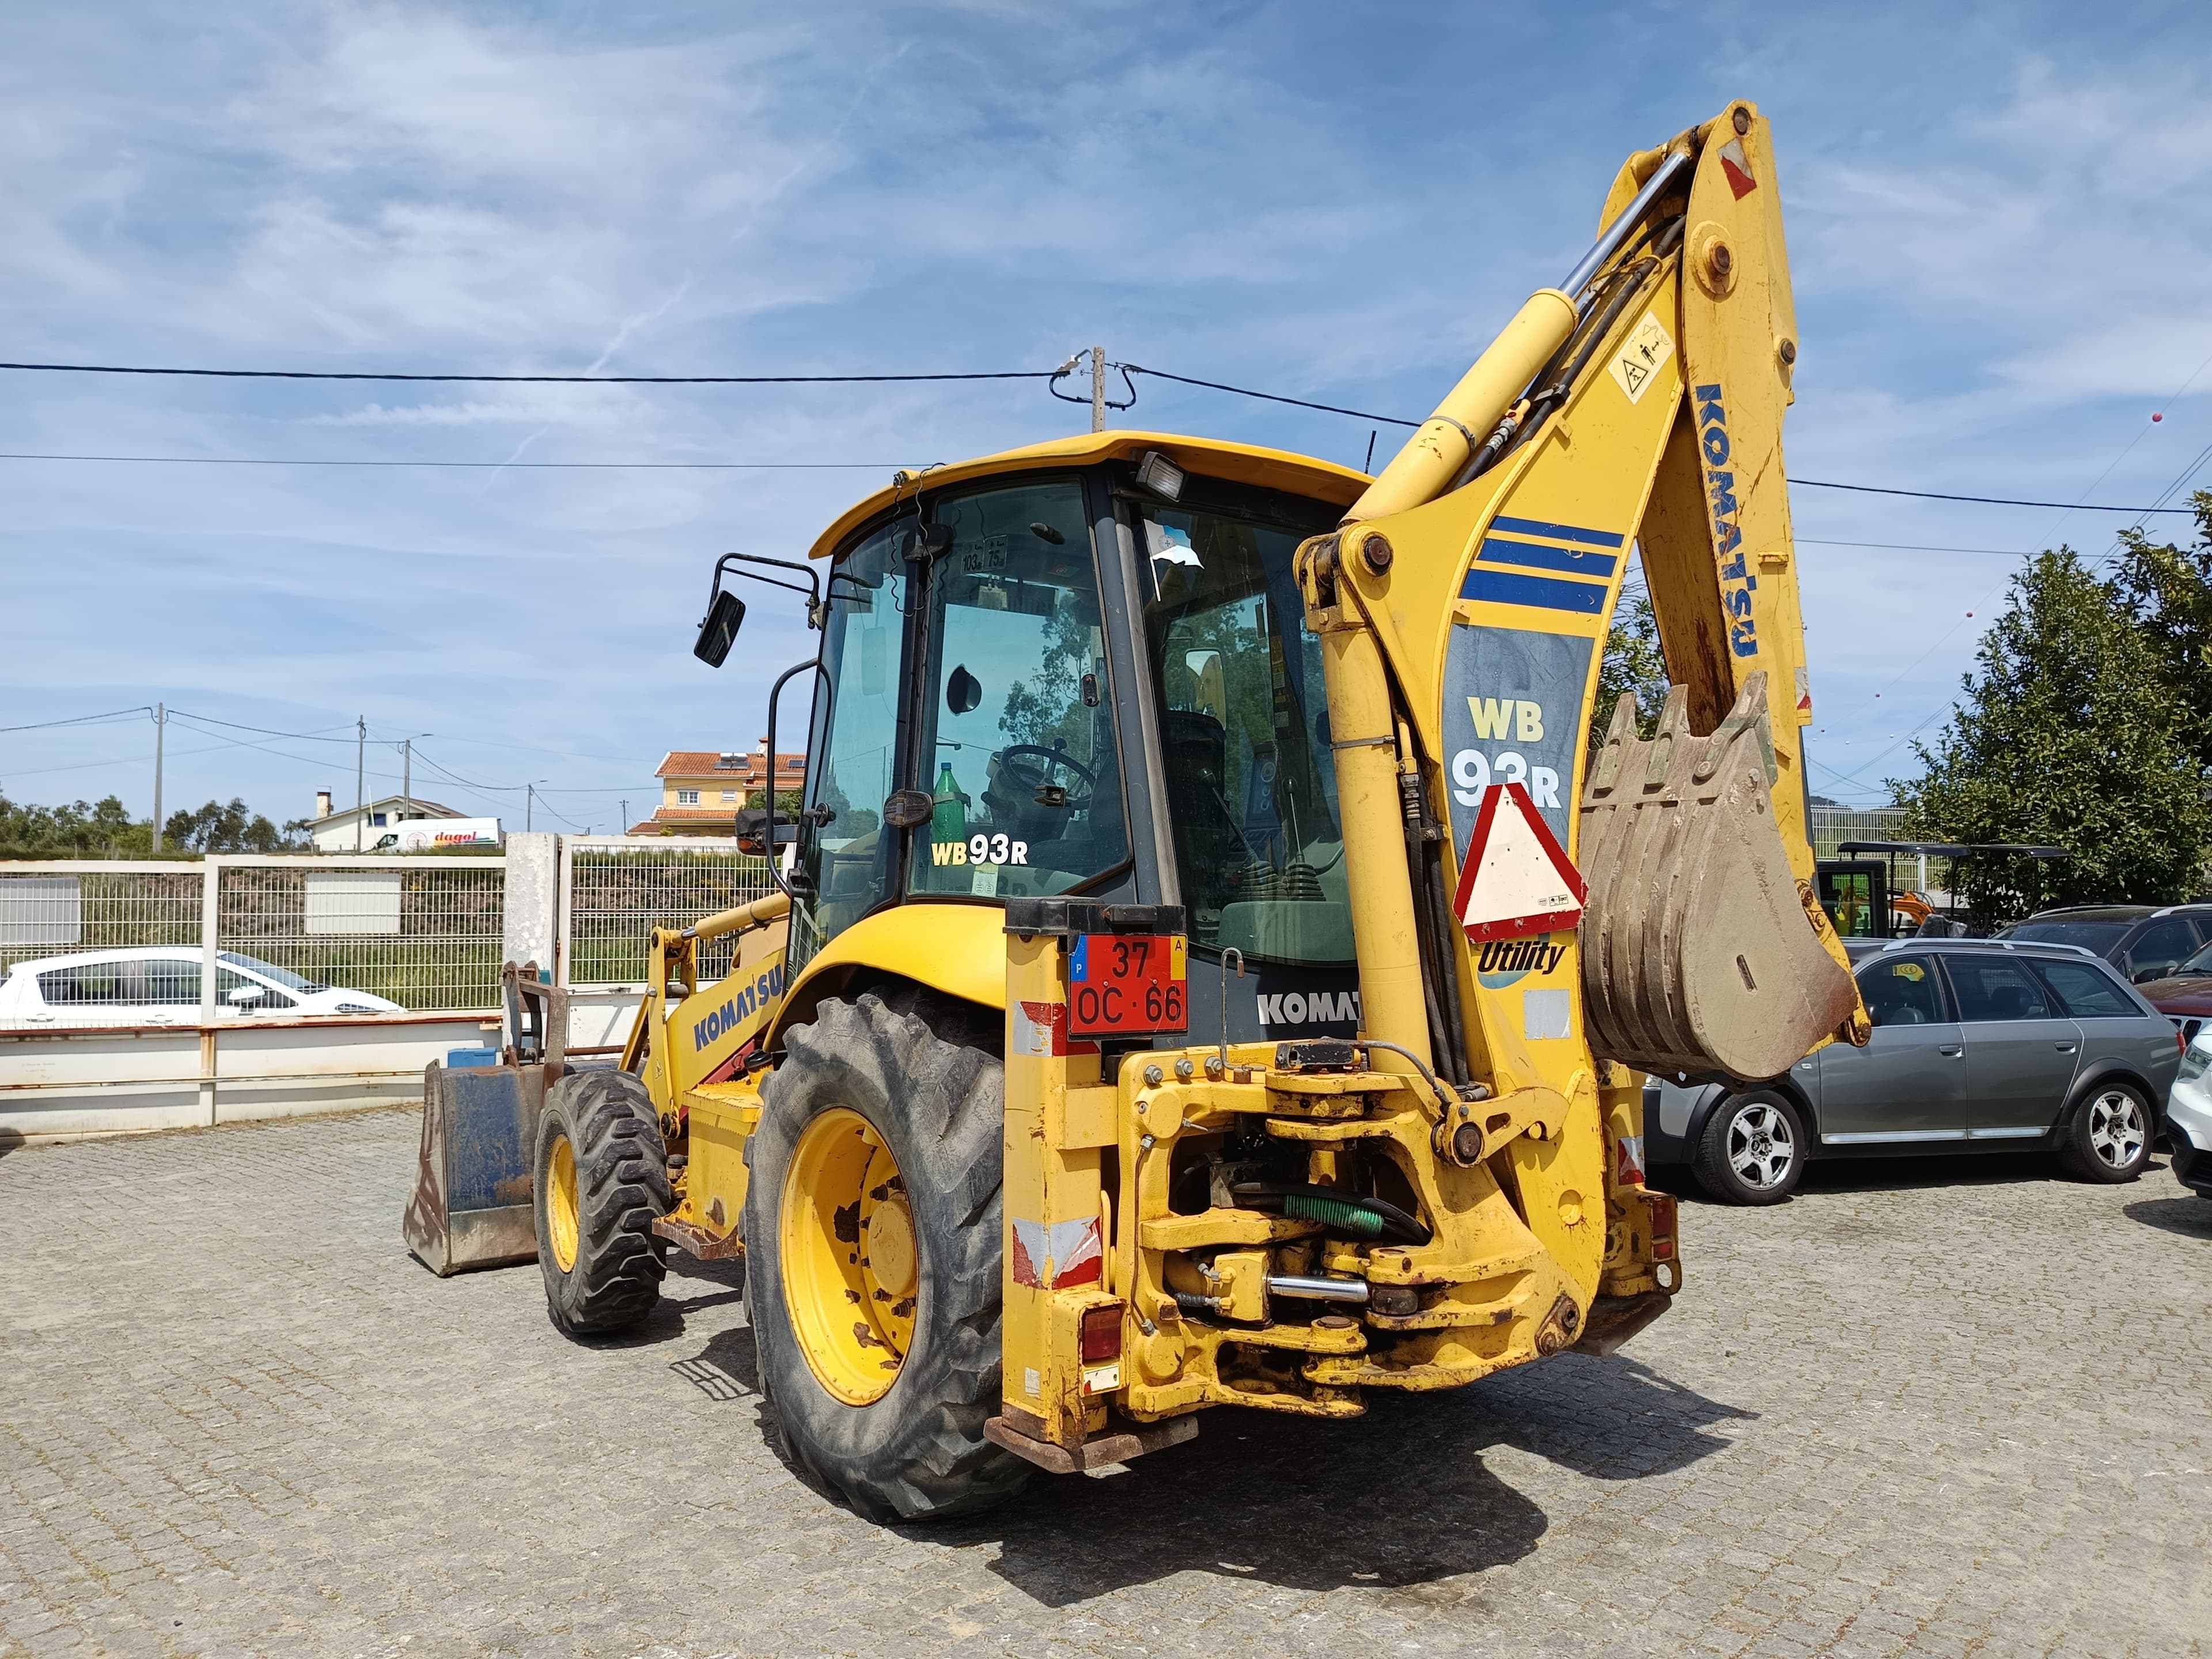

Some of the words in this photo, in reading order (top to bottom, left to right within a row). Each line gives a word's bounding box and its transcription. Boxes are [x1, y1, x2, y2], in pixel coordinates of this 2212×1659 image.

[1695, 384, 1758, 657] KOMATSU
[963, 553, 977, 571] 103
[1467, 696, 1544, 743] WB
[1112, 941, 1149, 978] 37
[1175, 940, 1183, 951] A
[1478, 941, 1567, 975] Utility
[1076, 963, 1082, 974] P
[694, 963, 783, 1052] KOMATSU
